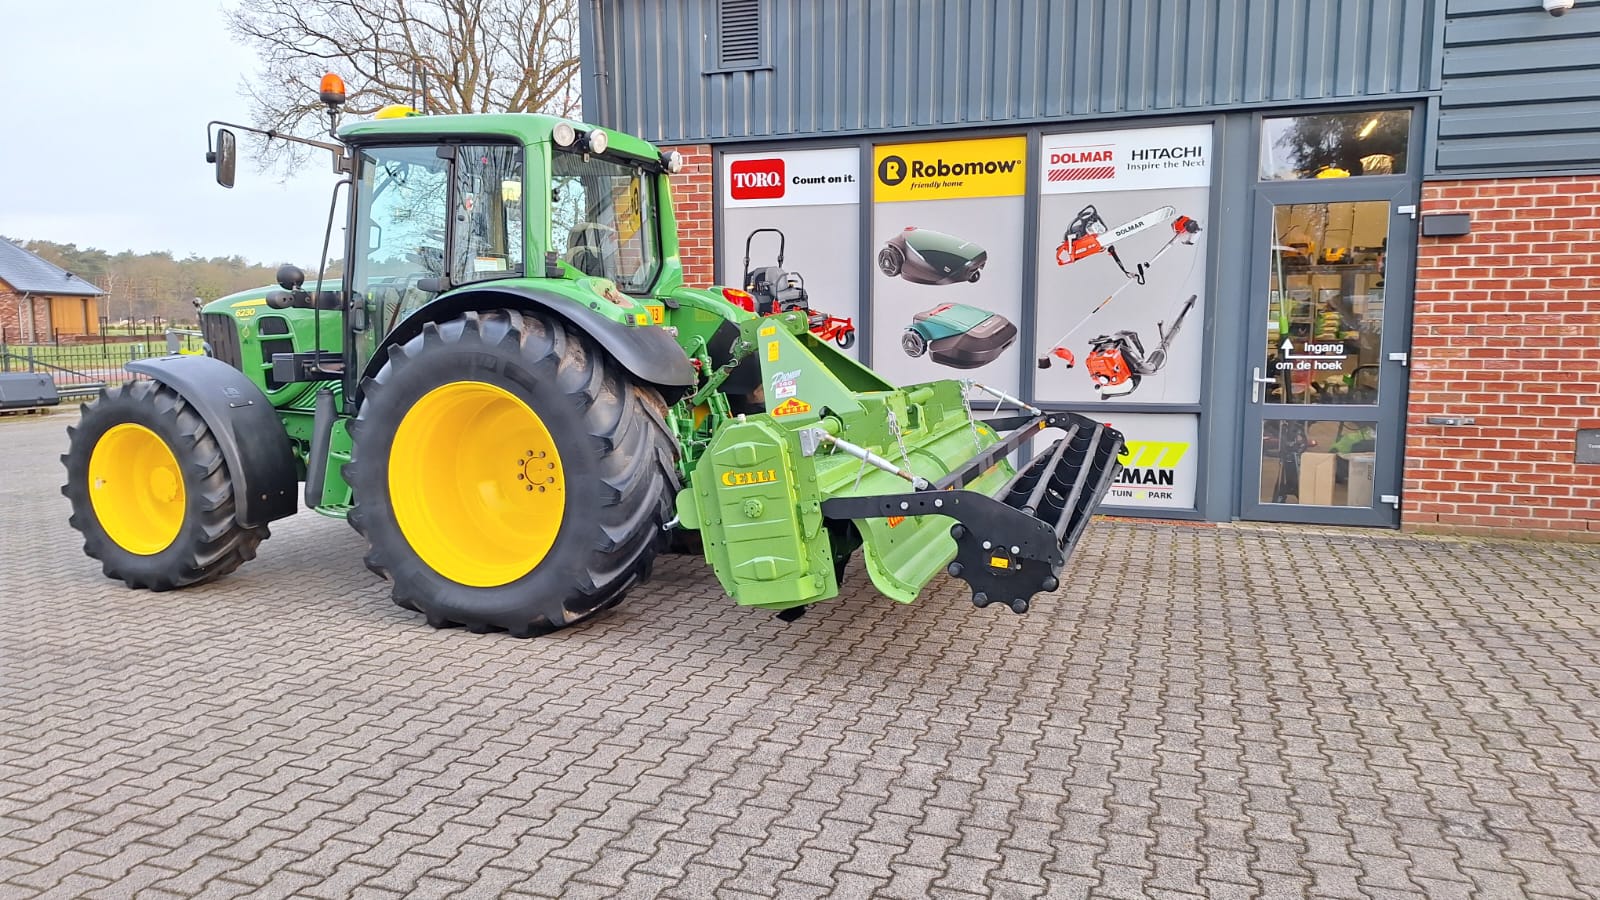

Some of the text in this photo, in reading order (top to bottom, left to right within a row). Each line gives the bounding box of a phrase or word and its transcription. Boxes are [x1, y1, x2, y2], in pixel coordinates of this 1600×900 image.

[1050, 151, 1113, 165] DOLMAR
[1131, 146, 1202, 161] HITACHI
[912, 159, 1016, 178] Robomow
[1127, 159, 1205, 171] Inspire the Next
[734, 172, 780, 188] TORO
[792, 176, 825, 184] Count
[844, 174, 855, 182] it.
[911, 181, 940, 190] friendly
[1115, 221, 1145, 237] DOLMAR
[1304, 342, 1344, 354] Ingang
[1275, 360, 1342, 370] om de hoek
[721, 469, 777, 486] CELLI
[1148, 491, 1172, 499] PARK
